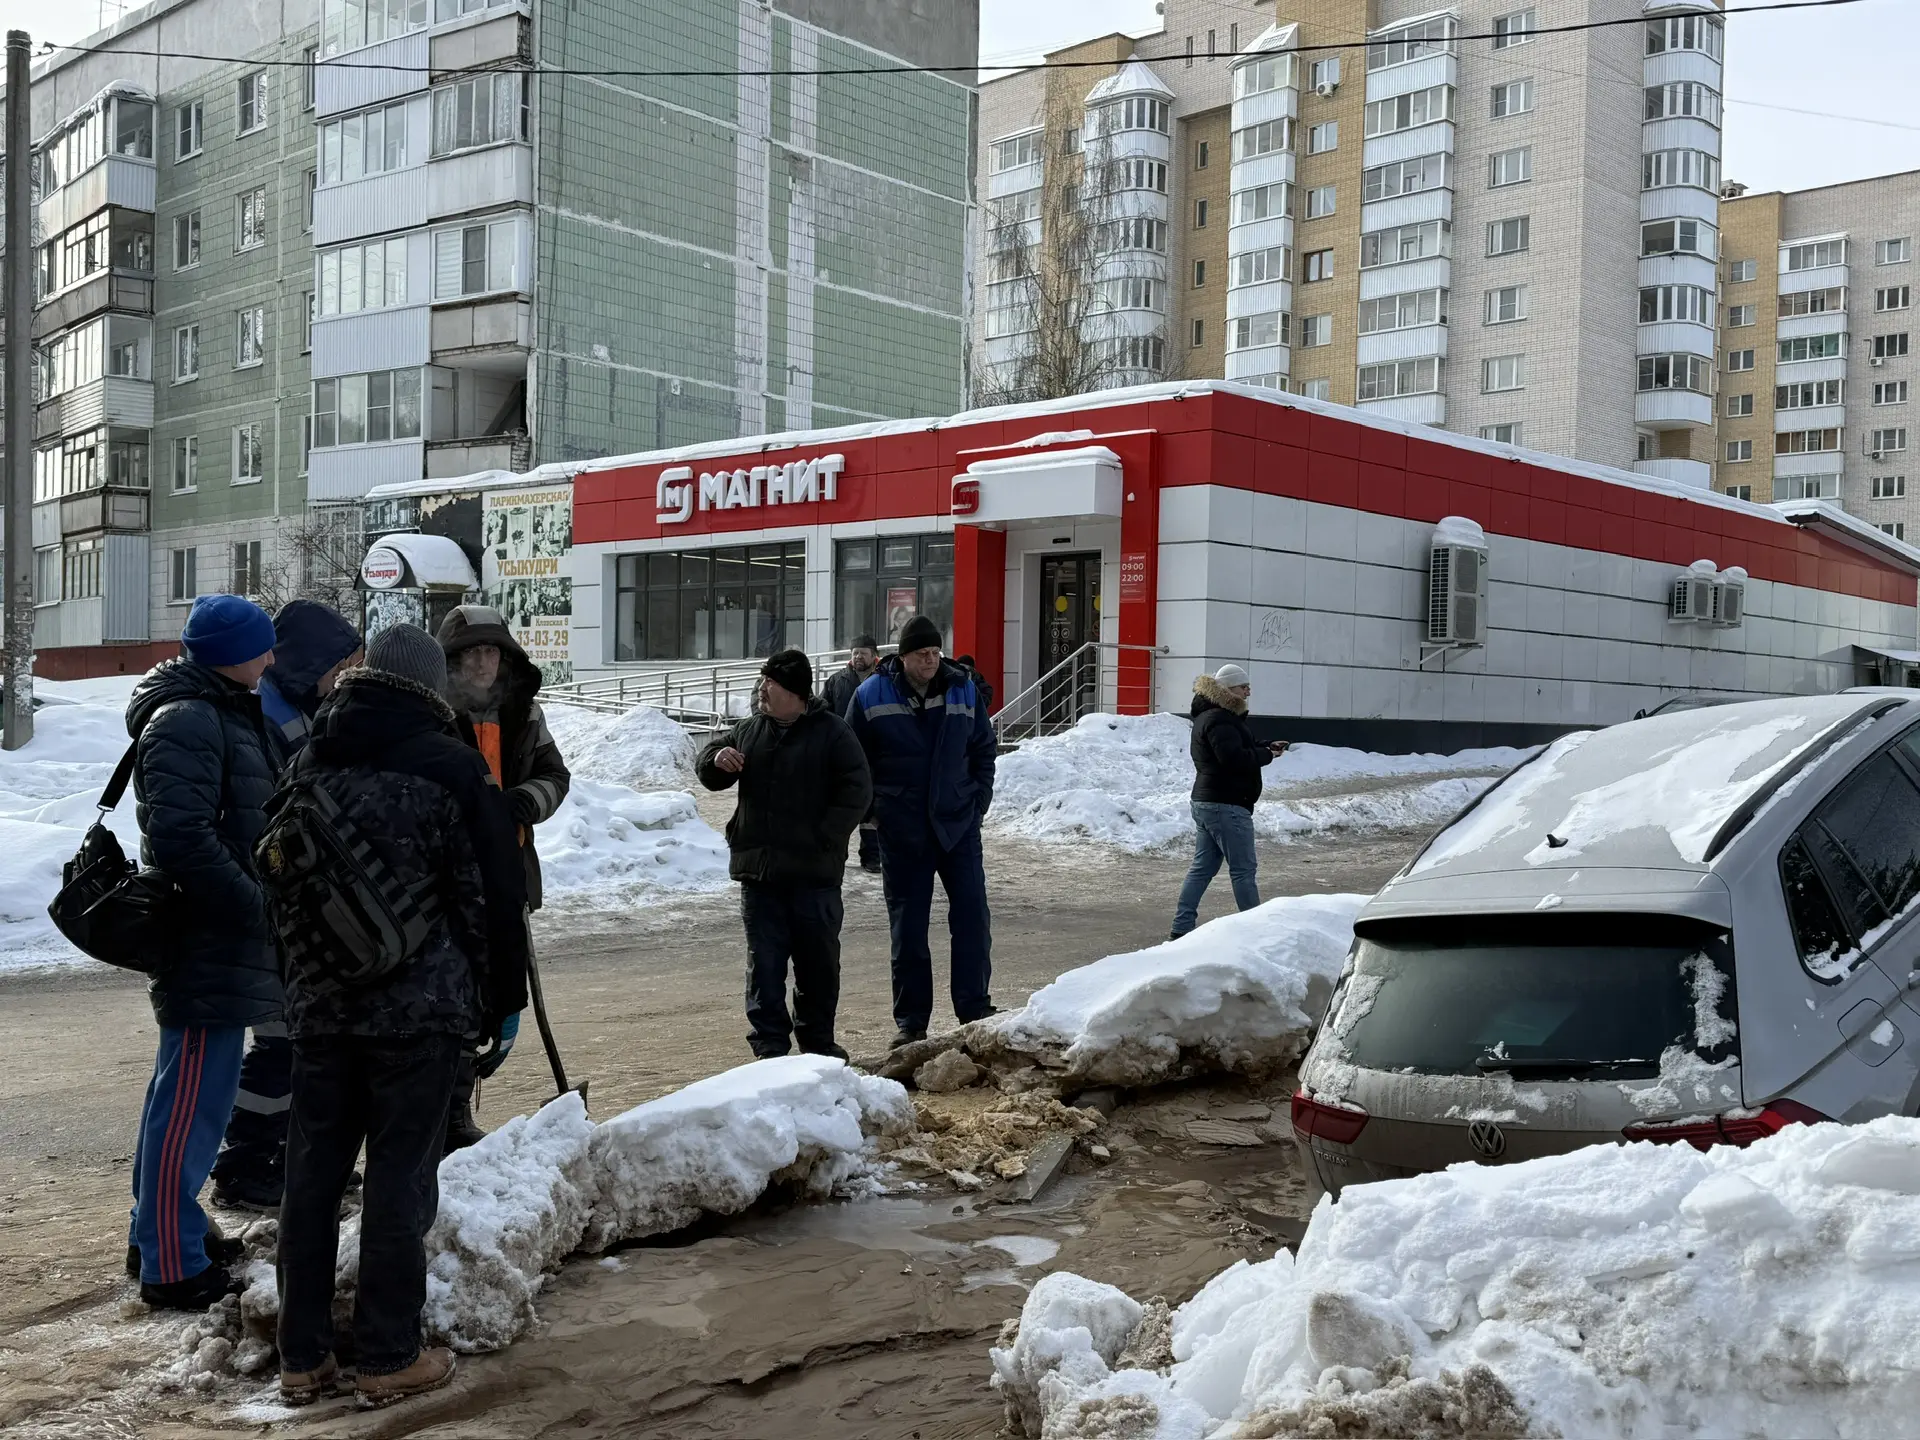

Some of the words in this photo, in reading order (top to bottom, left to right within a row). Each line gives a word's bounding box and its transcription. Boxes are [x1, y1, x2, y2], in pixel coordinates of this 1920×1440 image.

[699, 454, 845, 511] МАГНИТ
[490, 490, 569, 507] ПАРИКМАХЕРСКАЯ
[497, 558, 559, 577] УСЫКУДРИ
